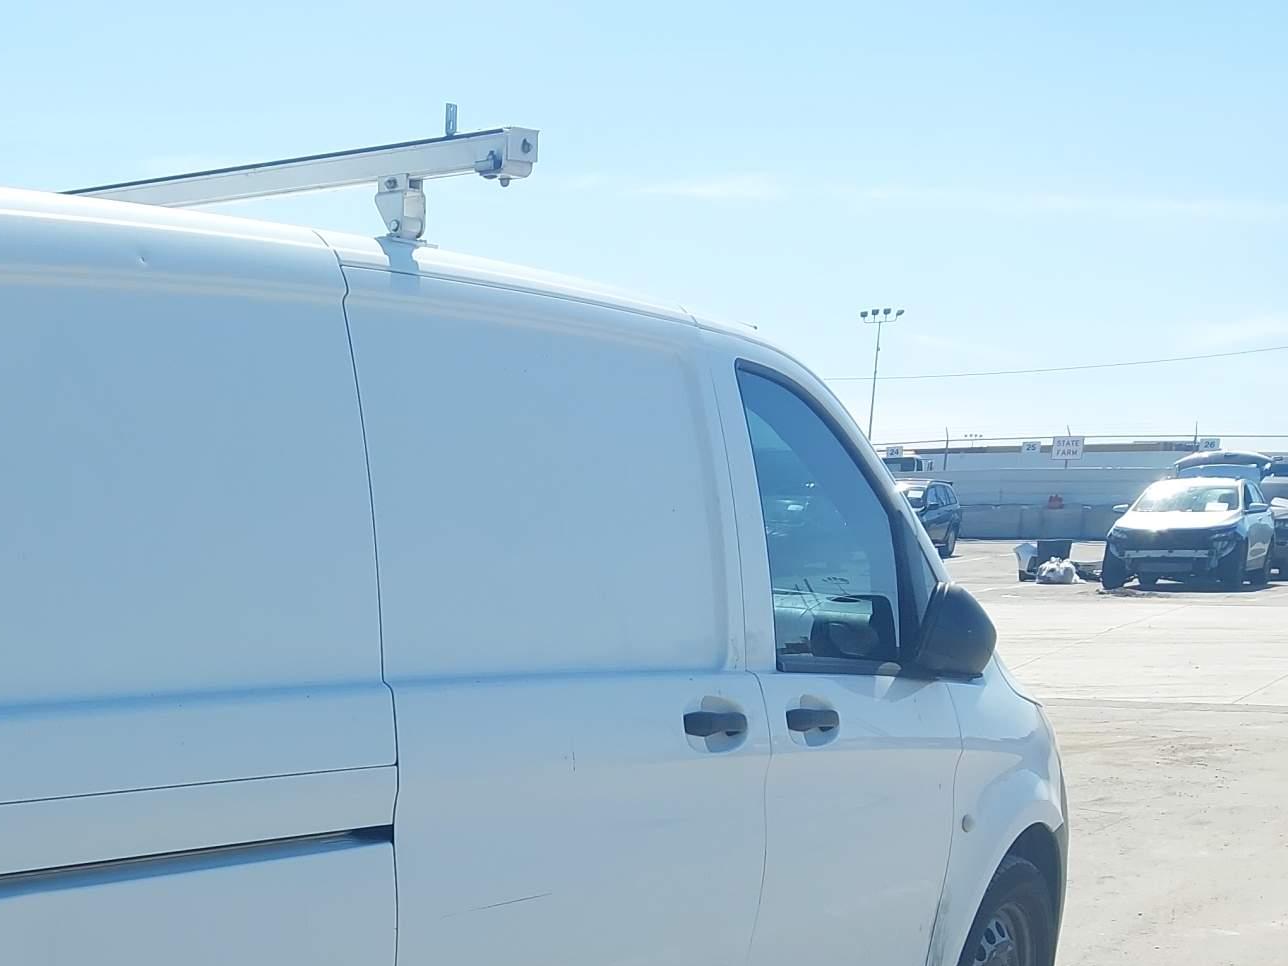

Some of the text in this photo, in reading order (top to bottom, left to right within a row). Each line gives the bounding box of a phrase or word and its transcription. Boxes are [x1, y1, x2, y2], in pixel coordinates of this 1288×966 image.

[1025, 443, 1038, 451] 25
[1055, 439, 1081, 448] STATE
[1203, 440, 1217, 449] 26
[888, 448, 900, 456] 24
[1055, 449, 1079, 457] FARM
